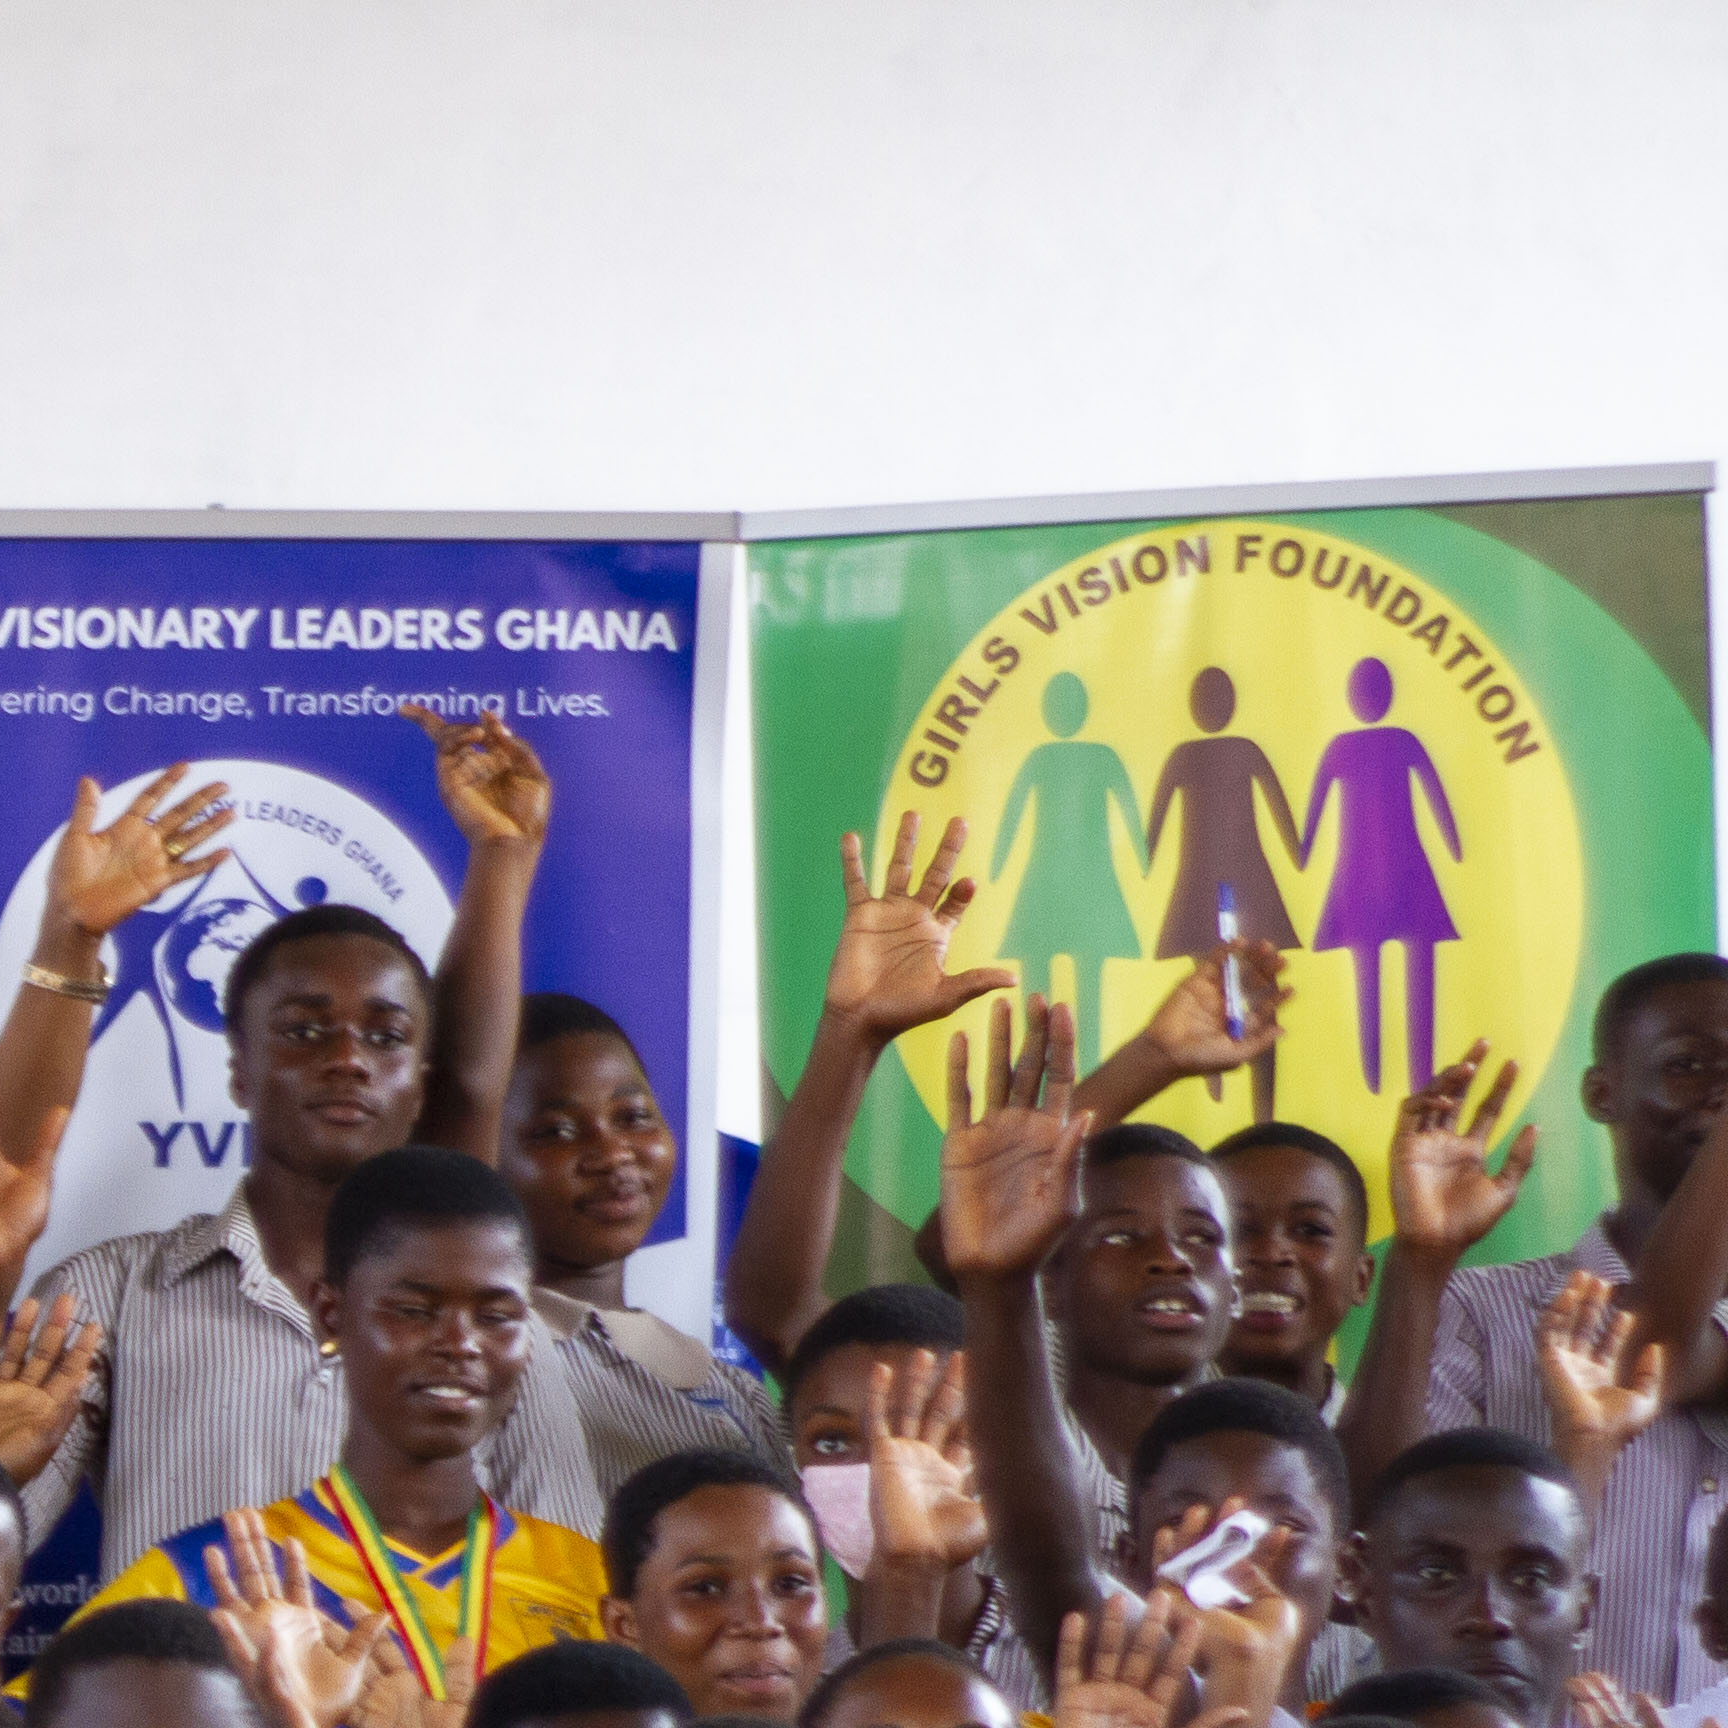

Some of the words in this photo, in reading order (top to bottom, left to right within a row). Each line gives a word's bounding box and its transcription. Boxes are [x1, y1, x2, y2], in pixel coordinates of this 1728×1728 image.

[269, 607, 485, 652] LEADERS
[495, 608, 678, 653] GHANA
[908, 636, 1022, 789] GIRLS
[1018, 536, 1212, 637] VISION
[1234, 535, 1541, 767] FOUNDATION
[102, 685, 254, 722] Change,
[261, 685, 507, 719] Transforming
[516, 687, 611, 718] Lives.
[244, 800, 343, 847] LEADERS
[344, 839, 406, 903] GHANA
